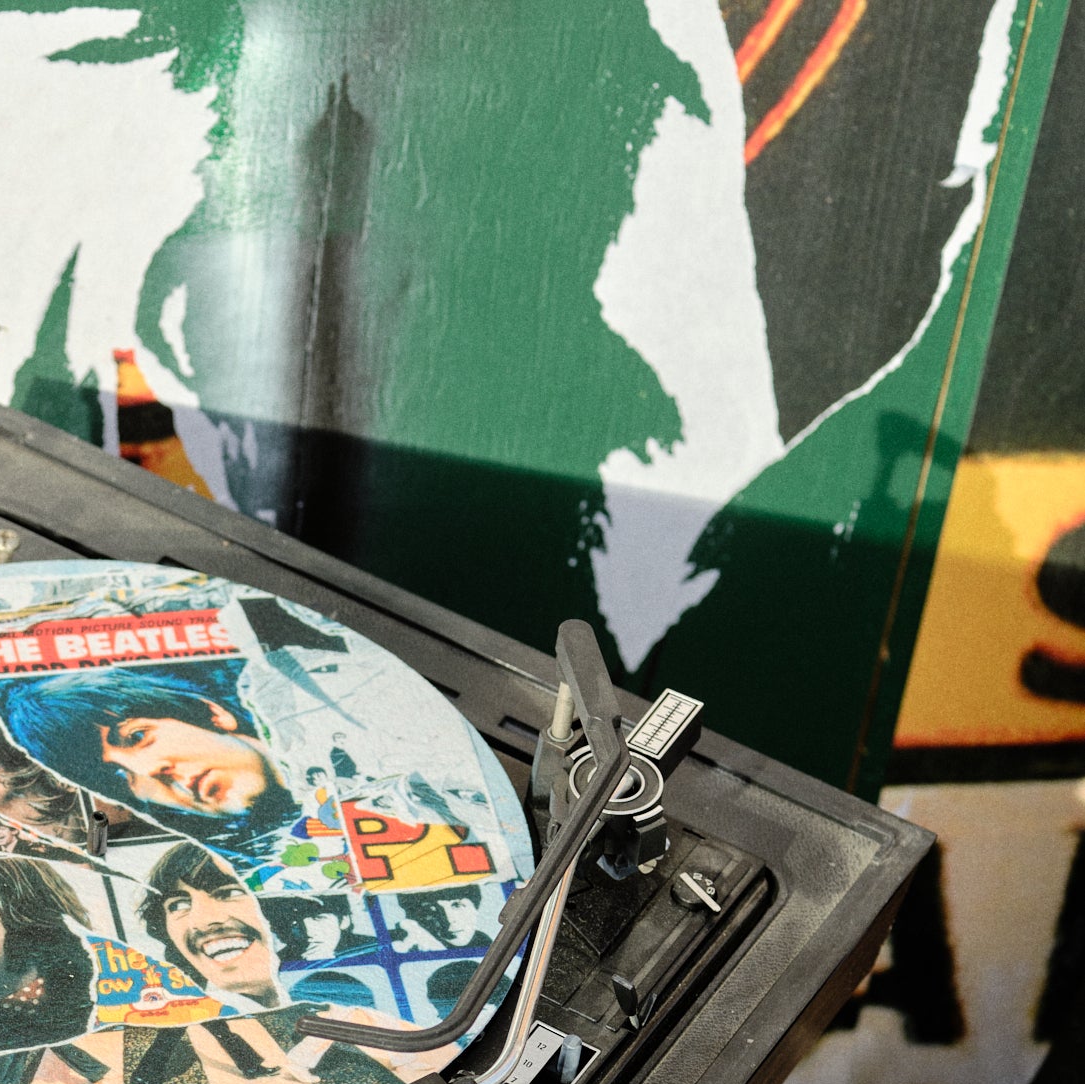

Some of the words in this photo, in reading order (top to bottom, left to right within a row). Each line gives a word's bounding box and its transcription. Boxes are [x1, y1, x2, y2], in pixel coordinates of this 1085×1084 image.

[81, 622, 133, 633] PICTURE
[139, 618, 183, 630] SOUND
[54, 622, 230, 661] BEATLES
[535, 1041, 548, 1051] 12
[522, 1058, 534, 1068] 10
